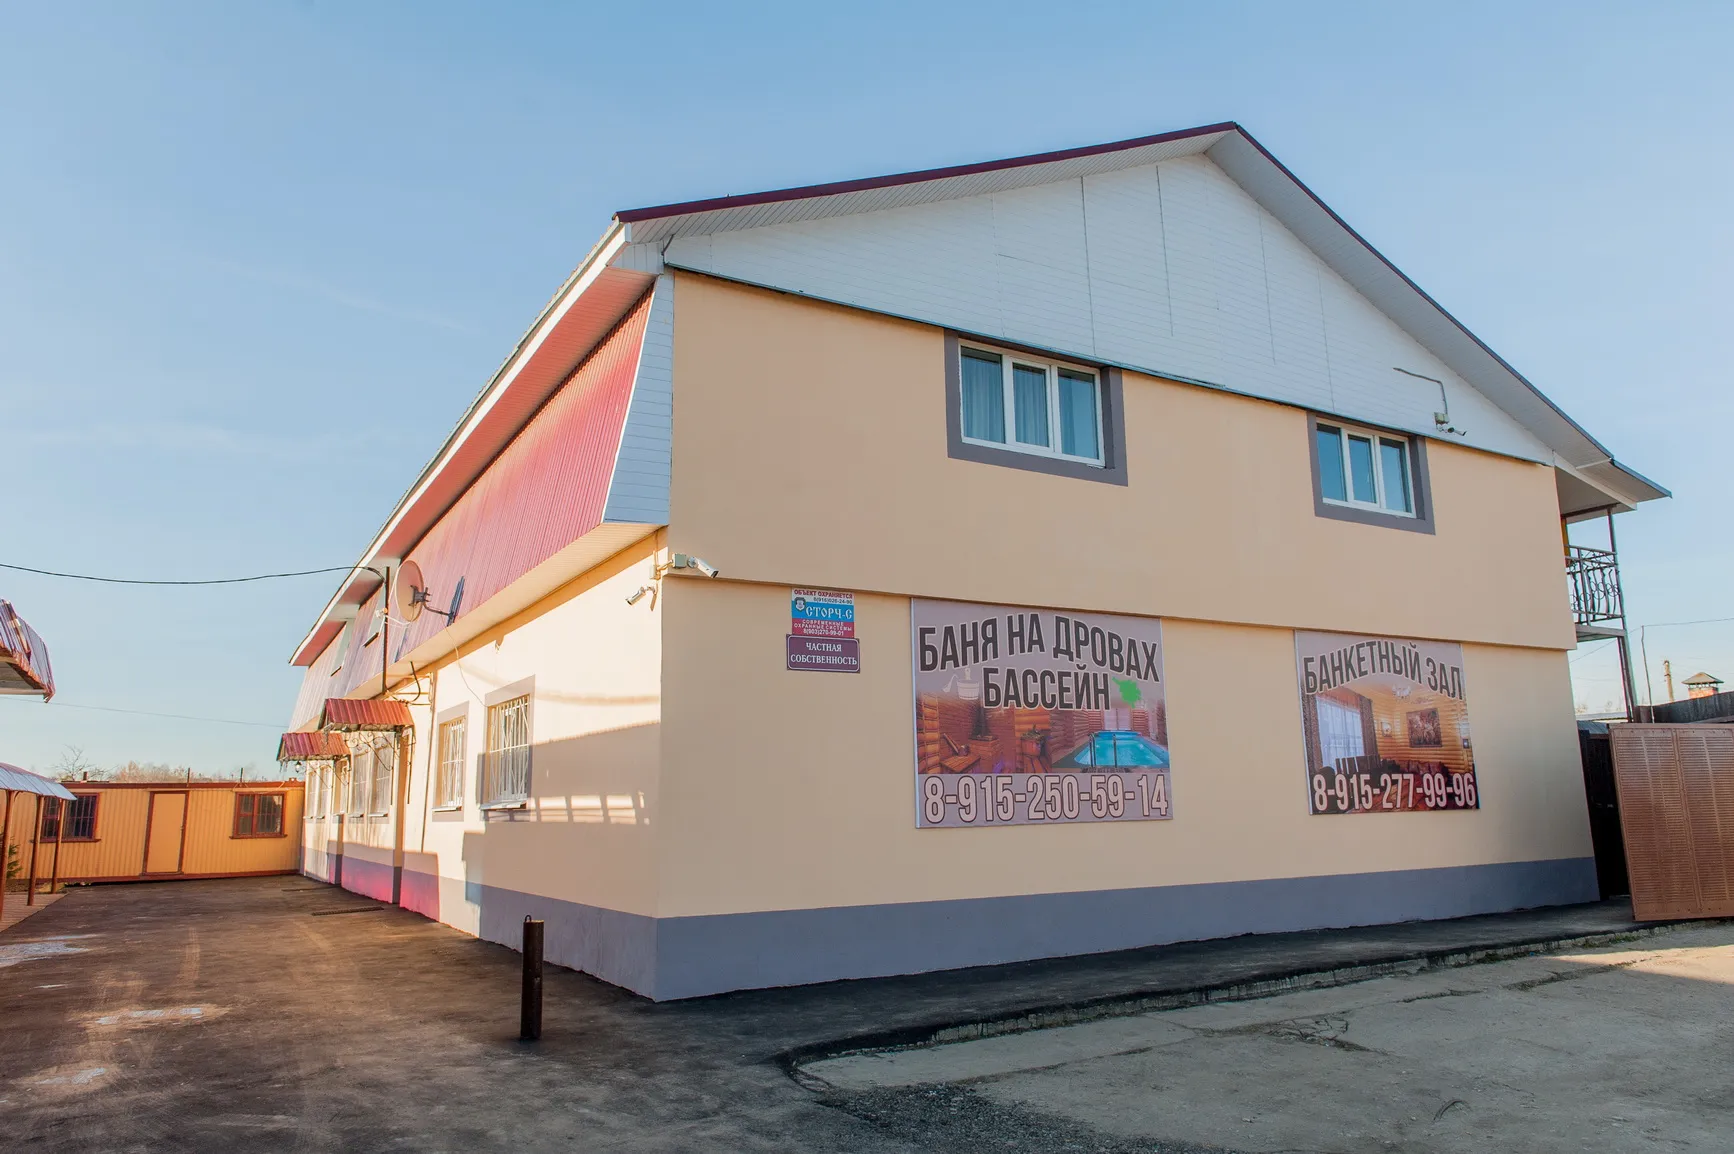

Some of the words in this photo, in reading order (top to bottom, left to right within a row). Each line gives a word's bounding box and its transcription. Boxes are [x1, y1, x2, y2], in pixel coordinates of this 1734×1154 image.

[818, 590, 853, 599] ОХРАНЯЕТСЯ
[802, 619, 844, 627] СОВРЕМЕННЫЕ
[805, 605, 853, 620] СТОРЧ-С
[790, 653, 858, 665] СОБСТВЕННОСТЬ
[805, 642, 842, 652] ЧАСТНАЯ
[918, 616, 999, 672] БАНЯ
[1005, 612, 1046, 656] НА
[1052, 613, 1160, 683] ДРОВАХ
[1302, 640, 1423, 695] БАНКЕТНЫЙ
[1425, 656, 1464, 701] ЗАЛ
[981, 663, 1112, 711] БАССЕЙН
[923, 774, 1169, 824] 8-915-250-59-14
[1313, 772, 1477, 811] 8-915-277-99-96
